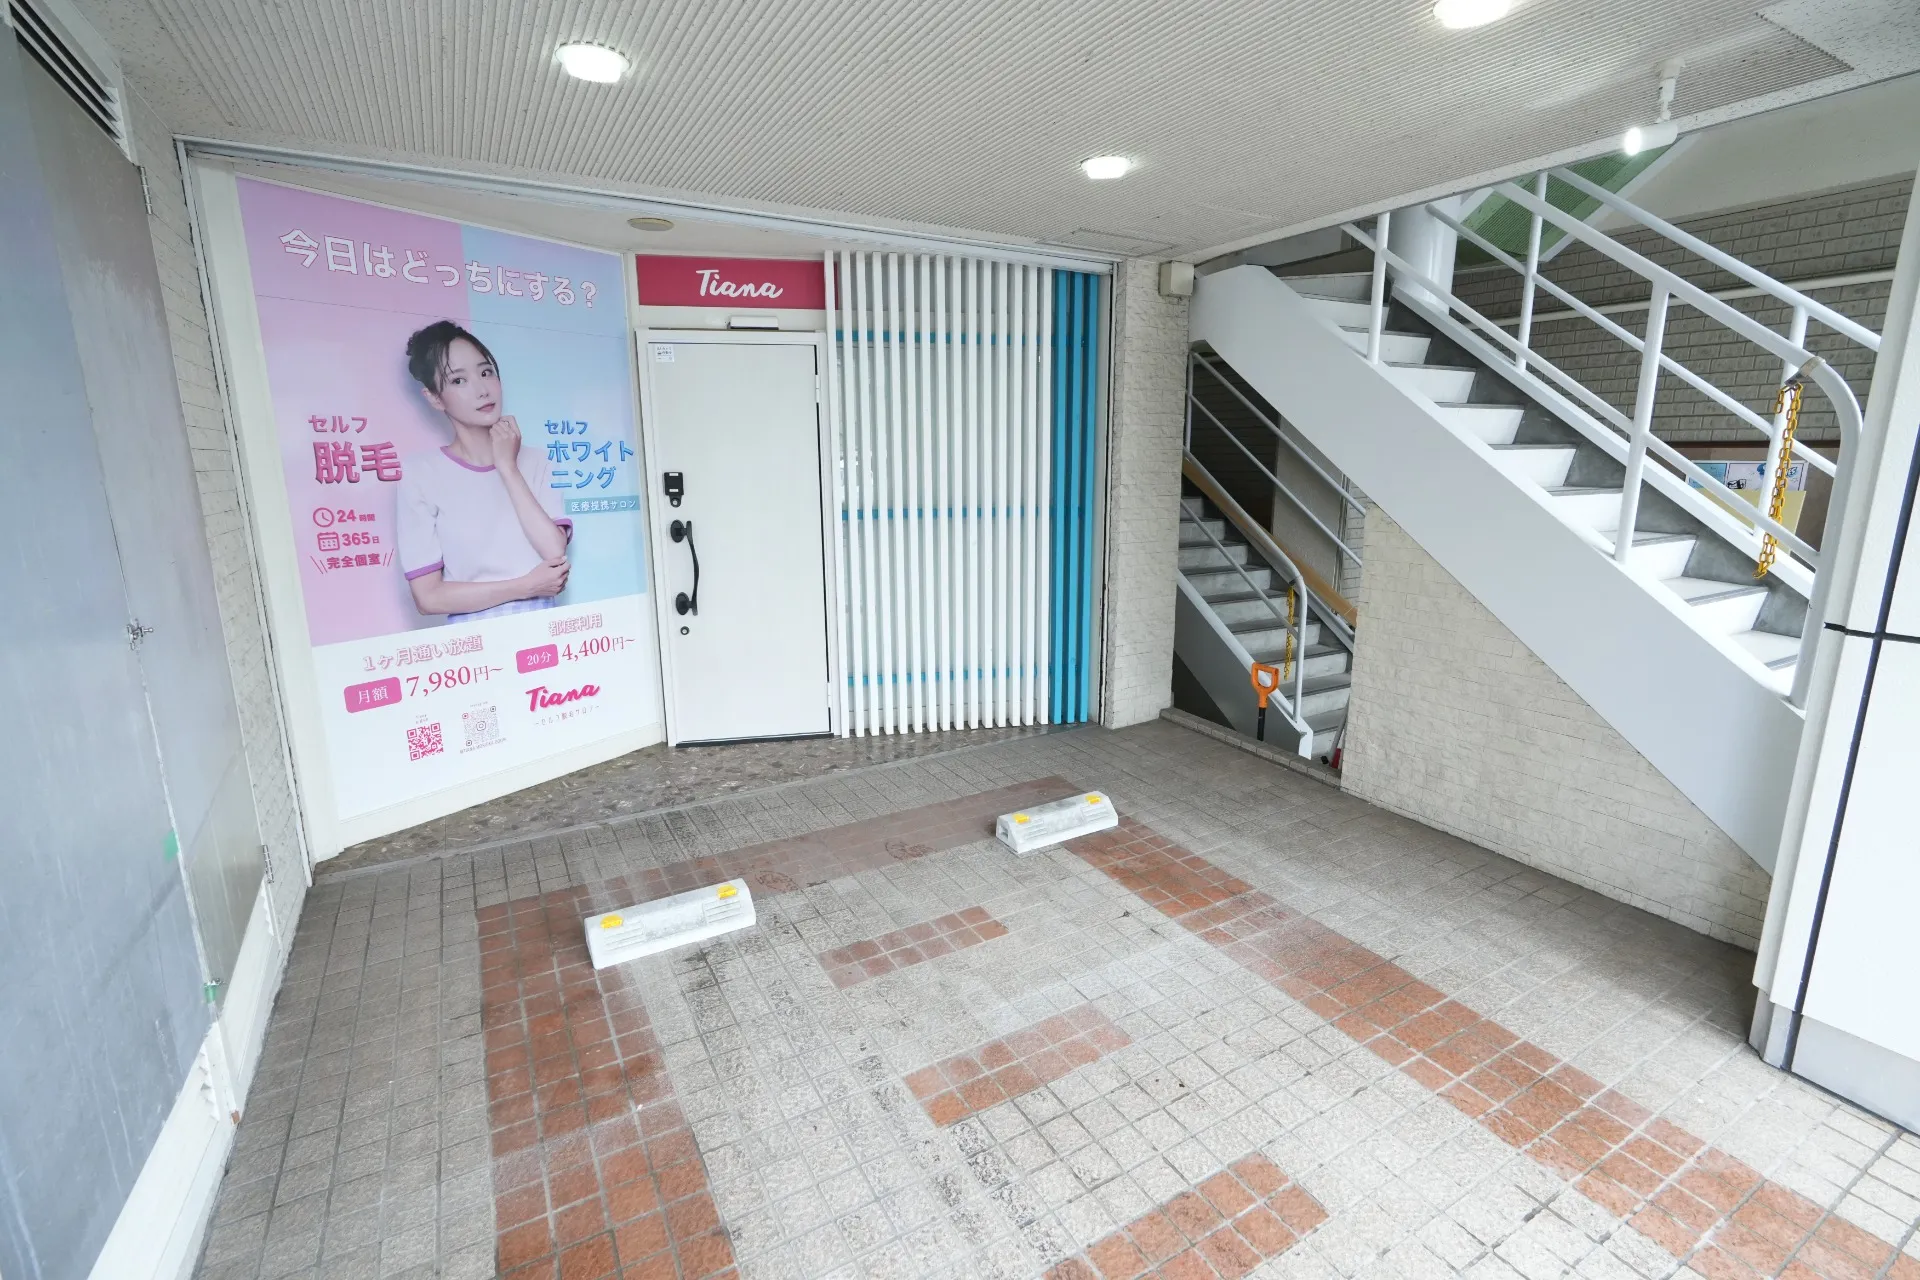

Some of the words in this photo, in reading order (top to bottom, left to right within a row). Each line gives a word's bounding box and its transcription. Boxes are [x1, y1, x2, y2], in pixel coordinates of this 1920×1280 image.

[695, 269, 783, 298] Tiana
[308, 415, 367, 433] セルフ
[544, 419, 588, 435] セルフ
[547, 440, 634, 463] ホワイト
[313, 441, 402, 484] 脱毛
[550, 466, 617, 489] ニング
[571, 499, 636, 512] 医療提携サロン
[341, 532, 380, 546] 365日
[326, 553, 381, 570] 完全個室
[548, 612, 603, 637] 都度利用
[358, 685, 389, 704] 月額
[525, 684, 600, 712] Tiana
